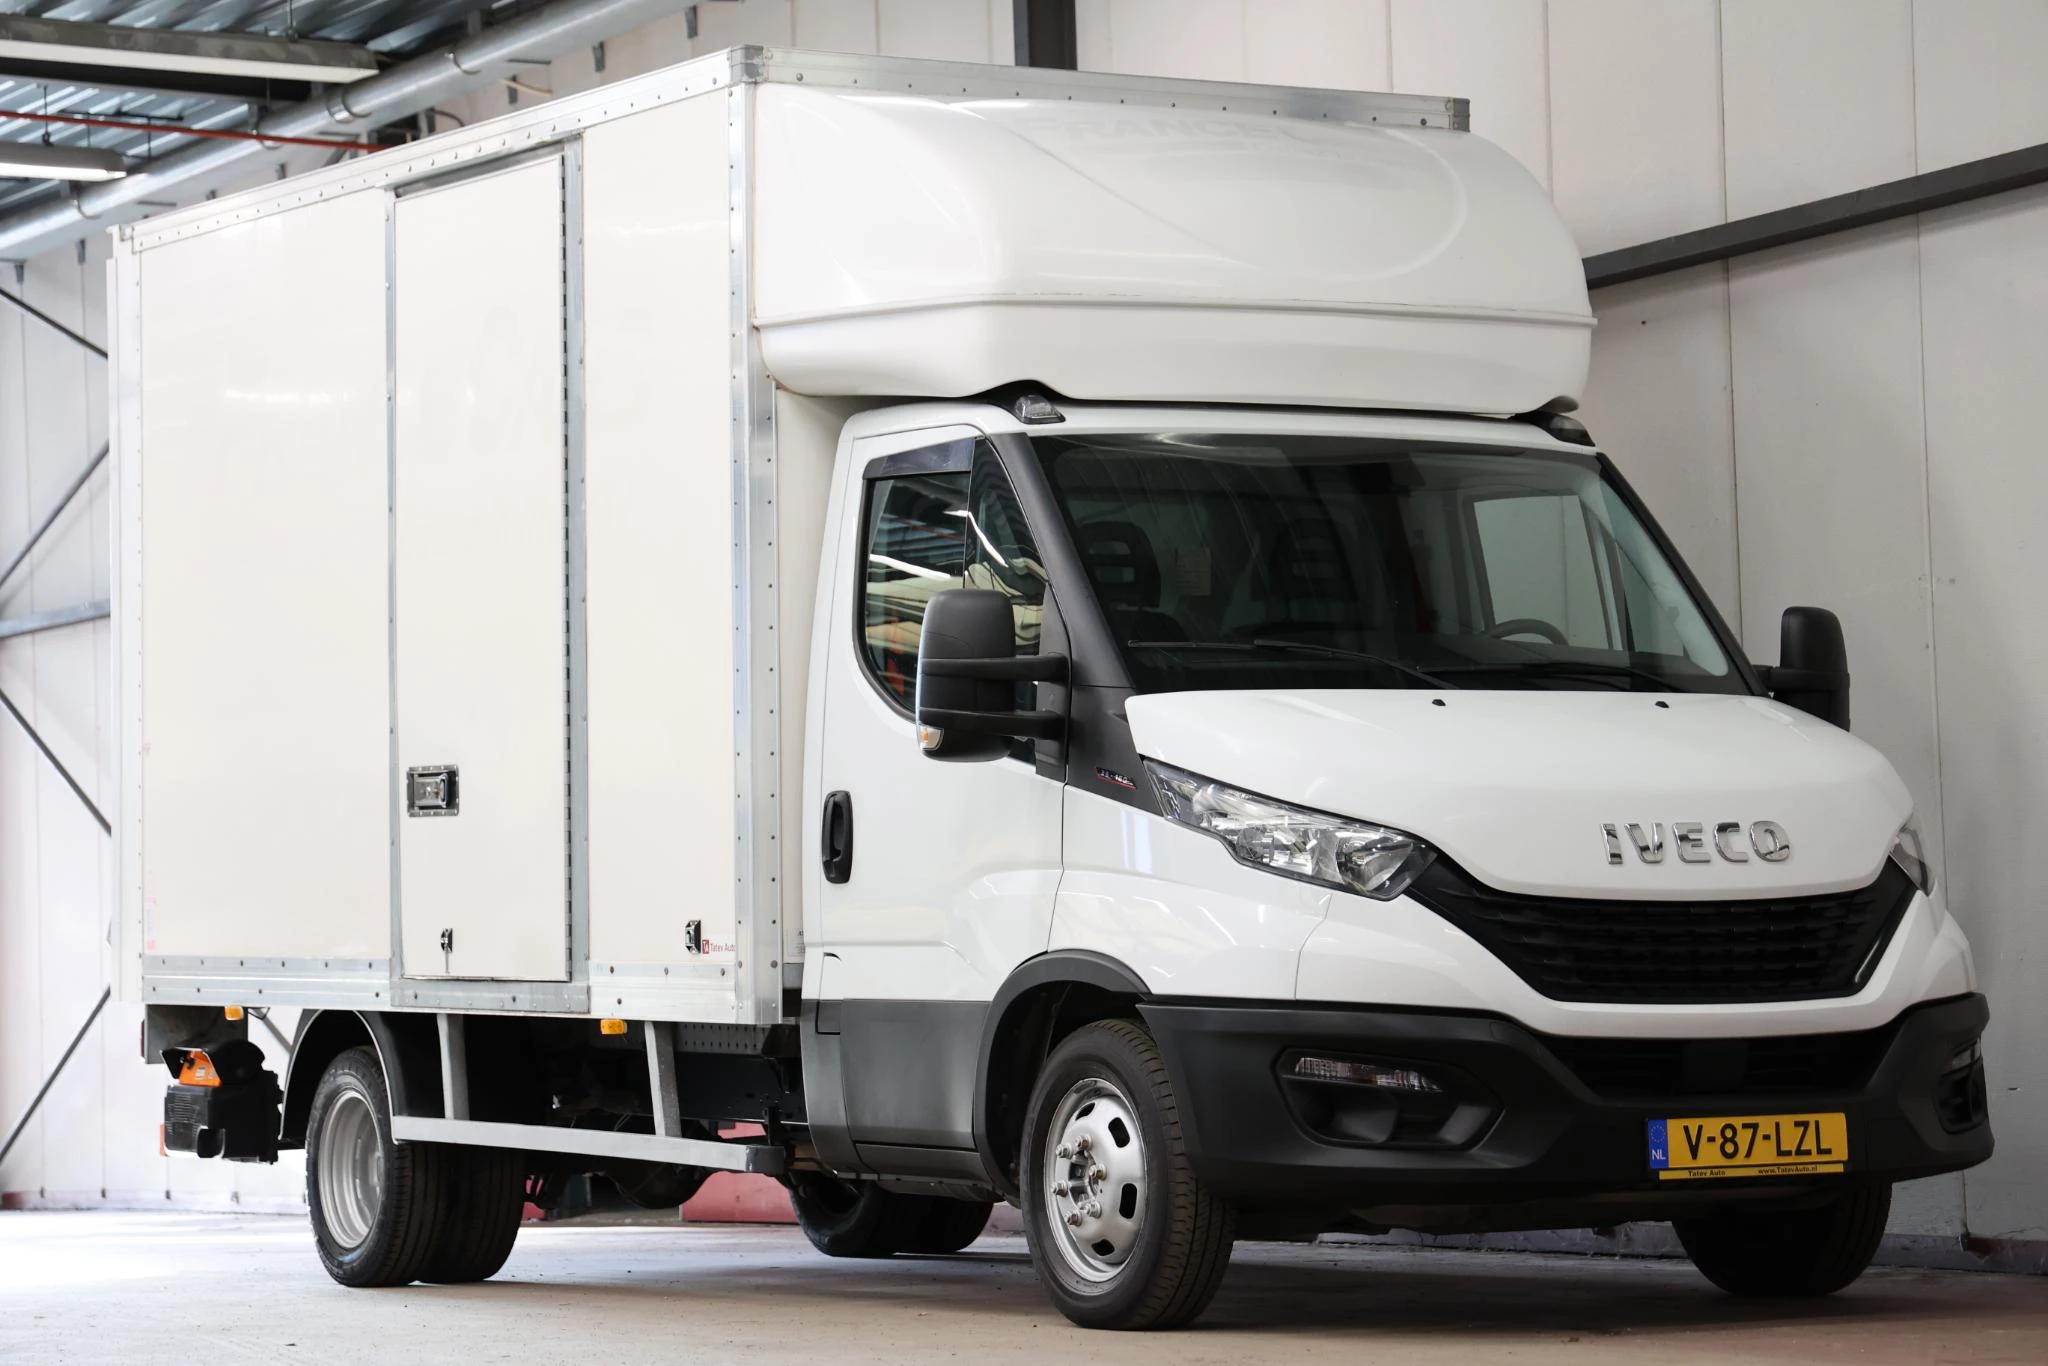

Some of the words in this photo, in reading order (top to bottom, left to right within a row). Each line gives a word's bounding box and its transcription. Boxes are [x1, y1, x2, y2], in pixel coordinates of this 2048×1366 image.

[1600, 820, 1791, 865] IVECO
[1652, 1149, 1665, 1160] NL
[1682, 1120, 1833, 1161] V-87-LZL
